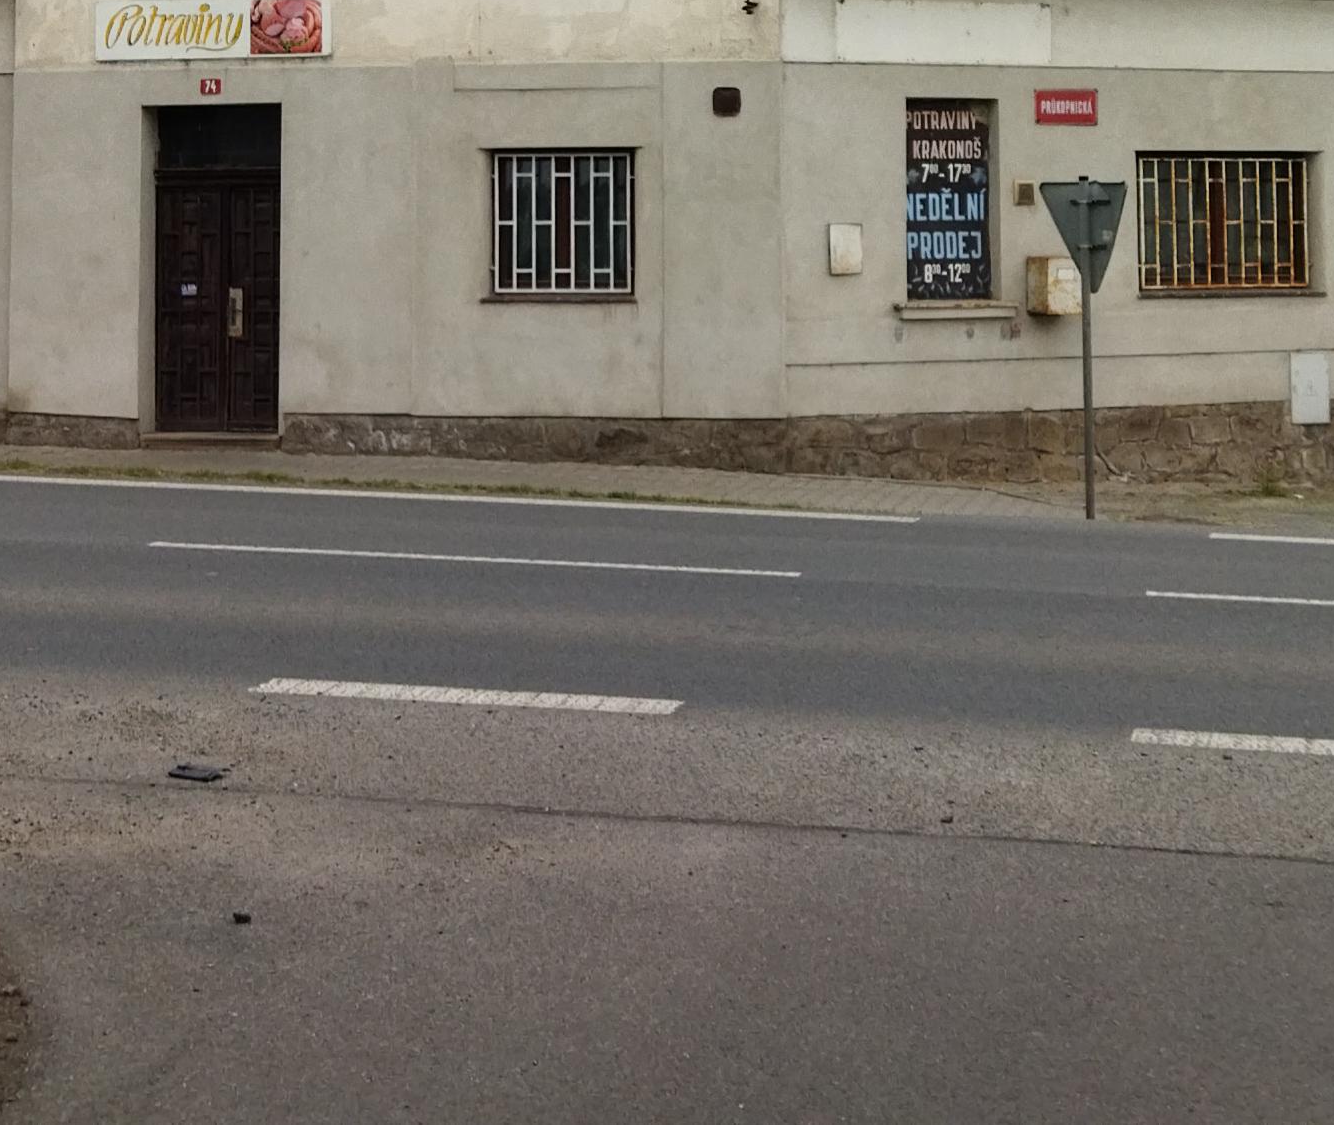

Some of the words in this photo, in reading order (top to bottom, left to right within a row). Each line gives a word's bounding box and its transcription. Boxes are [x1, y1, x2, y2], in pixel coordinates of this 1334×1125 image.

[105, 3, 244, 53] Potraviny
[205, 80, 217, 93] 74
[912, 136, 982, 159] KRAKONOŠ
[906, 187, 986, 221] NEDĚLNÍ
[907, 231, 982, 260] PRODEJ
